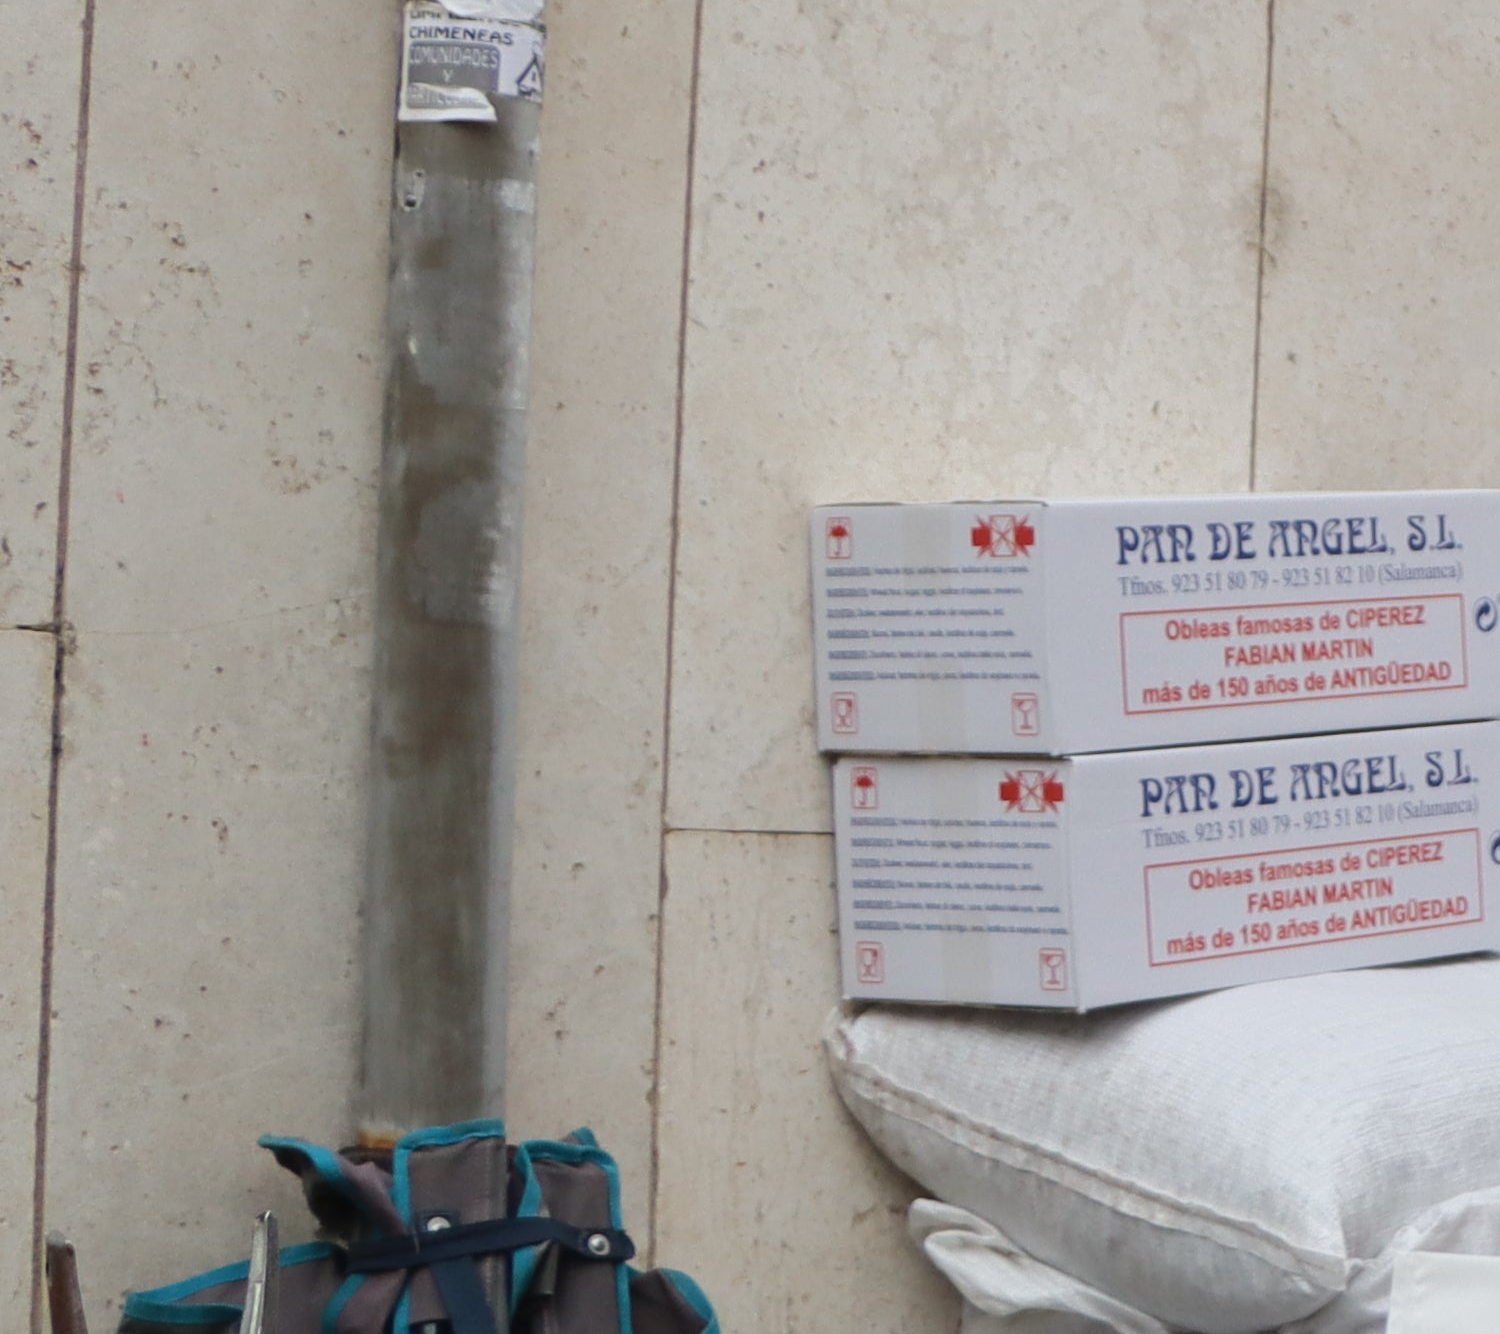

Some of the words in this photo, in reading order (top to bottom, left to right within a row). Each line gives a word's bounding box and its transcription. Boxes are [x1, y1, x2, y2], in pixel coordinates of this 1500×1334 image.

[409, 26, 514, 46] CHIMENEAS
[442, 69, 453, 83] Y
[1116, 522, 1196, 566] PAN
[1206, 521, 1257, 562] DE
[1171, 572, 1200, 594] 923
[1203, 571, 1222, 592] 51
[1226, 571, 1247, 591] 80
[1249, 570, 1269, 590] 79
[1282, 568, 1310, 588] 923
[1313, 567, 1332, 587] 51
[1335, 566, 1354, 585] 82
[1357, 565, 1376, 584] 10
[1378, 562, 1464, 586] (Salamanca)
[1165, 616, 1231, 641] Obleas
[1236, 611, 1314, 638] famosas
[1319, 609, 1341, 632] de
[1345, 605, 1425, 630] CIPEREZ
[1224, 643, 1296, 667] FABIAN
[1301, 638, 1373, 662] MARTIN
[1142, 679, 1183, 705] más
[1188, 677, 1211, 700] de
[1216, 676, 1249, 699] 150
[1254, 672, 1299, 696] años
[1304, 669, 1326, 690] de
[1330, 661, 1453, 689] ANTIGÜEDAD
[1139, 771, 1219, 818] PAN
[1229, 767, 1279, 808] DE
[1194, 822, 1223, 844] 923
[1227, 819, 1244, 840] 51
[1249, 818, 1269, 838] 80
[1272, 814, 1292, 835] 79
[1303, 810, 1330, 832] 923
[1333, 807, 1351, 828] 51
[1355, 805, 1373, 825] 82
[1376, 803, 1394, 823] 10
[1397, 794, 1480, 824] (Salamanca)
[1189, 868, 1254, 892] Obleas
[1259, 860, 1336, 884] famosas
[1340, 852, 1361, 874] de
[1366, 841, 1445, 870] CIPEREZ
[1247, 888, 1318, 915] FABIAN
[1322, 877, 1393, 904] MARTIN
[1166, 928, 1206, 957] más
[1212, 924, 1234, 948] de
[1240, 918, 1272, 945] 150
[1277, 912, 1320, 940] años
[1325, 908, 1347, 931] de
[1350, 896, 1469, 930] ANTIGÜEDAD
